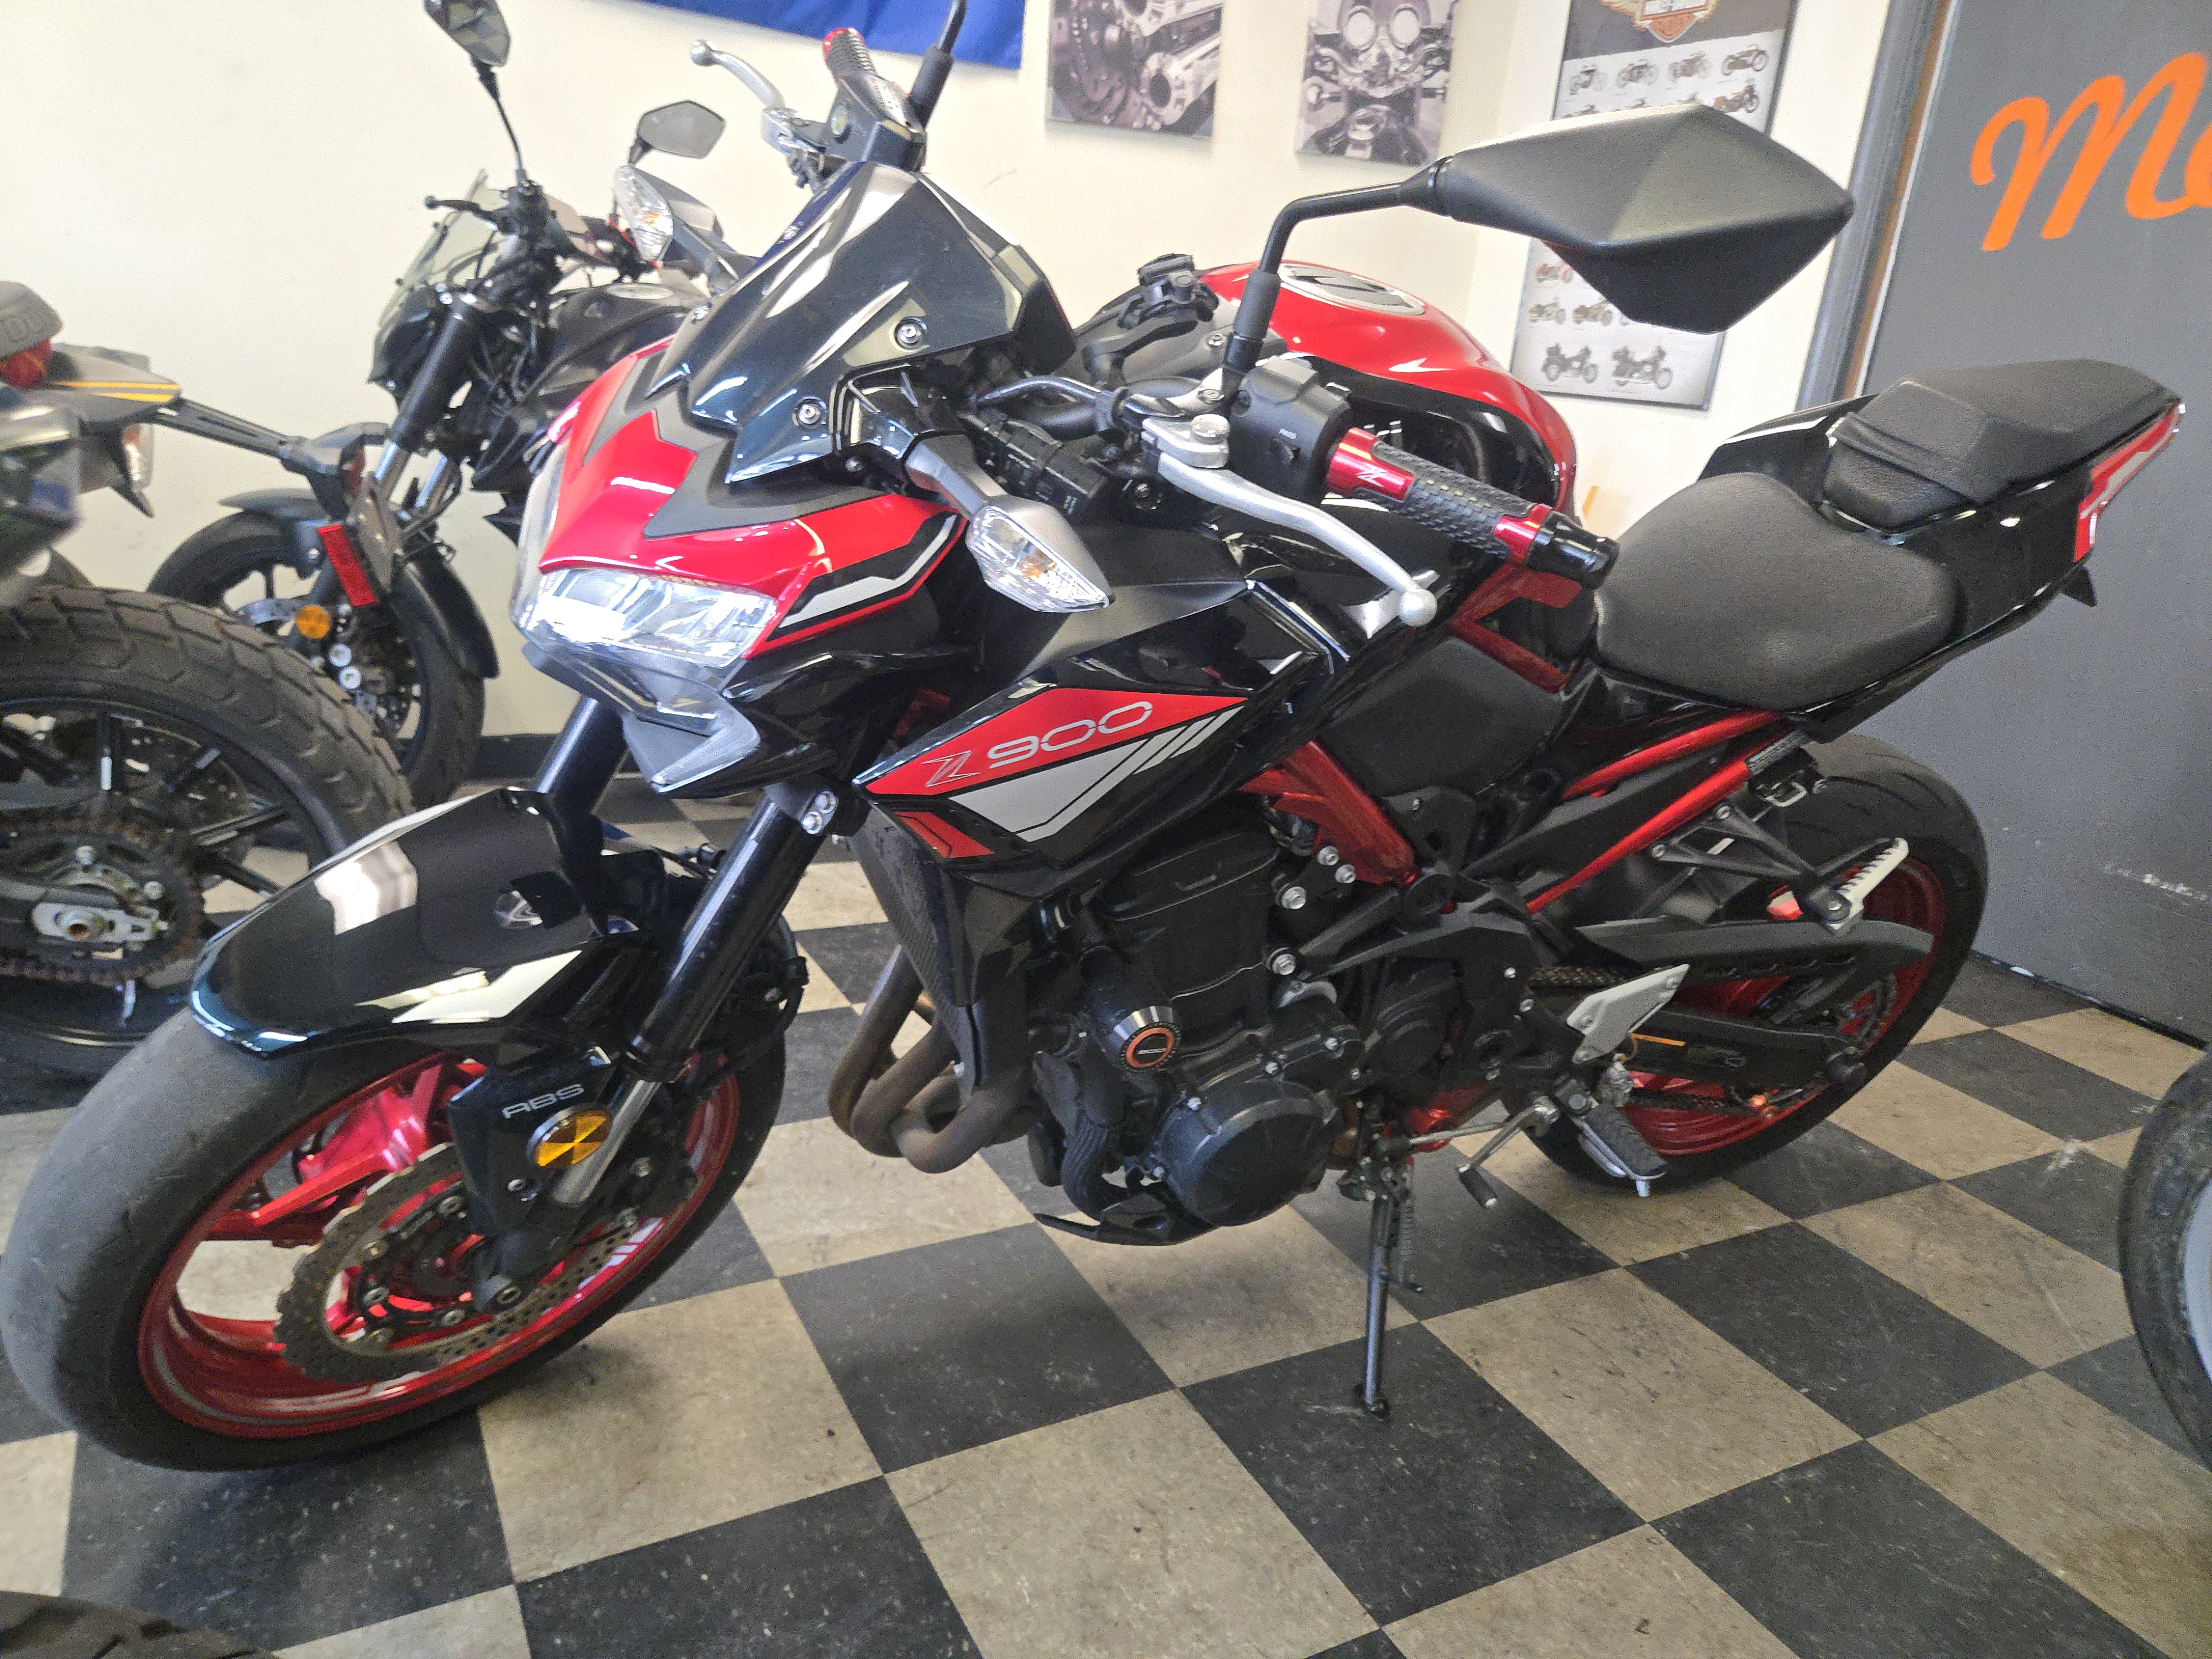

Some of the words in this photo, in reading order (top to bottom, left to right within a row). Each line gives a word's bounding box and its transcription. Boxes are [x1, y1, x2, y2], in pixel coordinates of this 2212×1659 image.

[922, 750, 980, 787] Z
[987, 701, 1153, 769] 900
[502, 1084, 585, 1119] ABS
